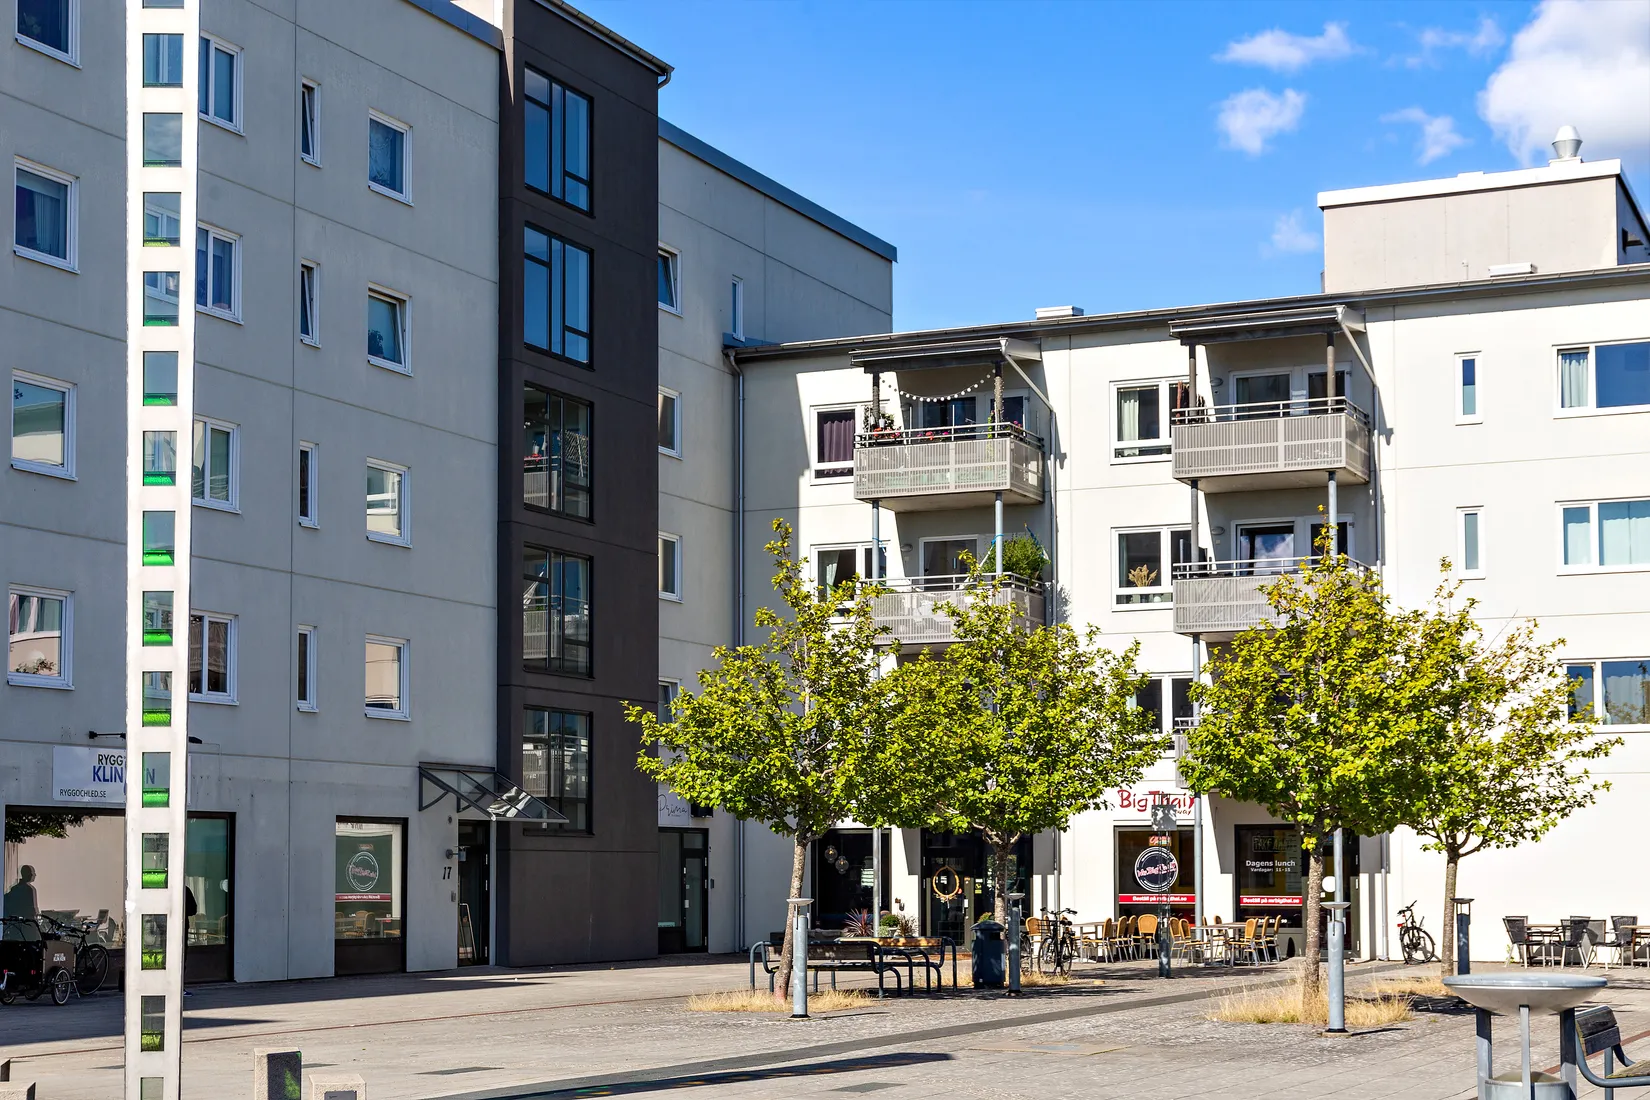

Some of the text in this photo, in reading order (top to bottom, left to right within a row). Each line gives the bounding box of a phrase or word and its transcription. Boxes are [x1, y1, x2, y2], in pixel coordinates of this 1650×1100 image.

[59, 788, 107, 798] RYGGOCHLED.SE
[1245, 860, 1274, 868] Dagens
[442, 866, 452, 880] 17
